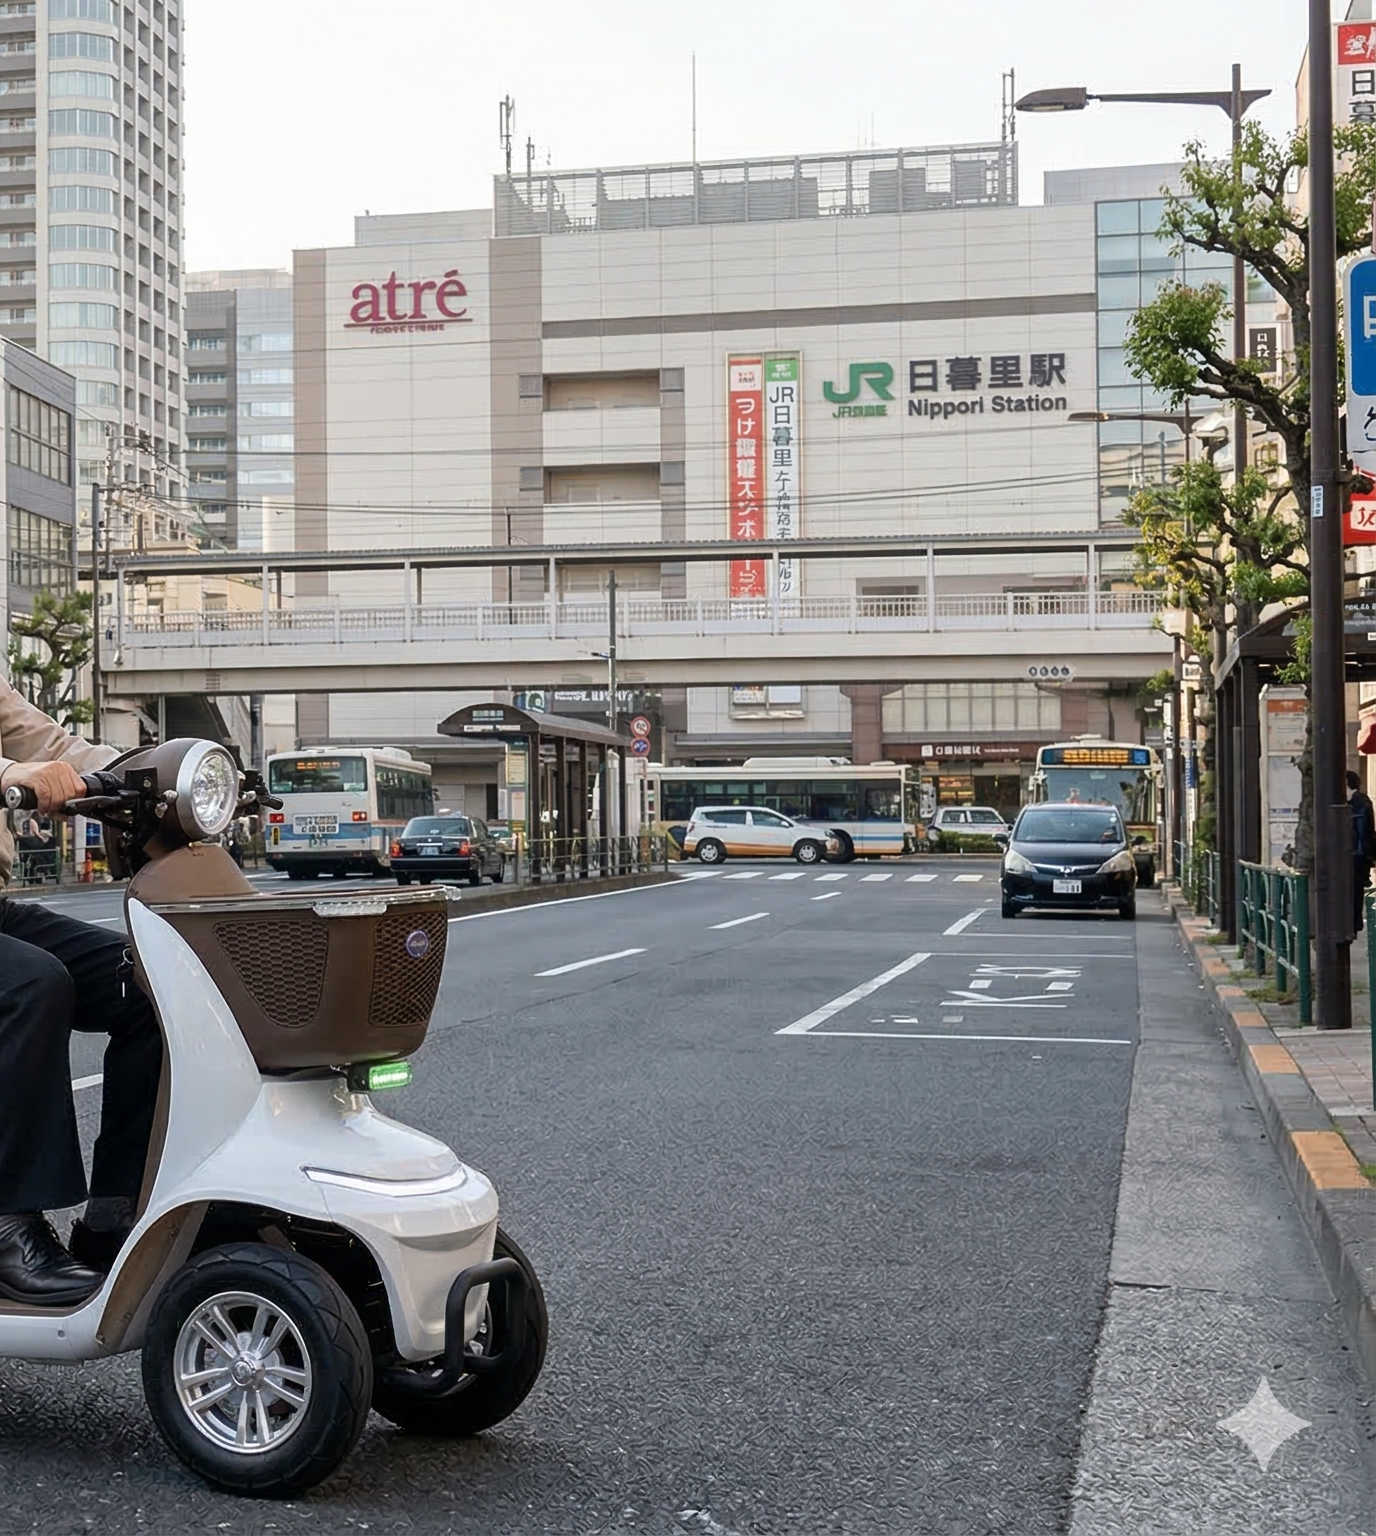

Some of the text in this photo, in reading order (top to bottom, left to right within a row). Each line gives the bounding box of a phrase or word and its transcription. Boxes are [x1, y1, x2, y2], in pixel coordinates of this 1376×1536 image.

[350, 269, 467, 323] atré
[823, 362, 895, 404] JR
[909, 353, 1066, 394] 日暮里駅
[908, 397, 984, 420] Nippori
[991, 394, 1067, 413] Station
